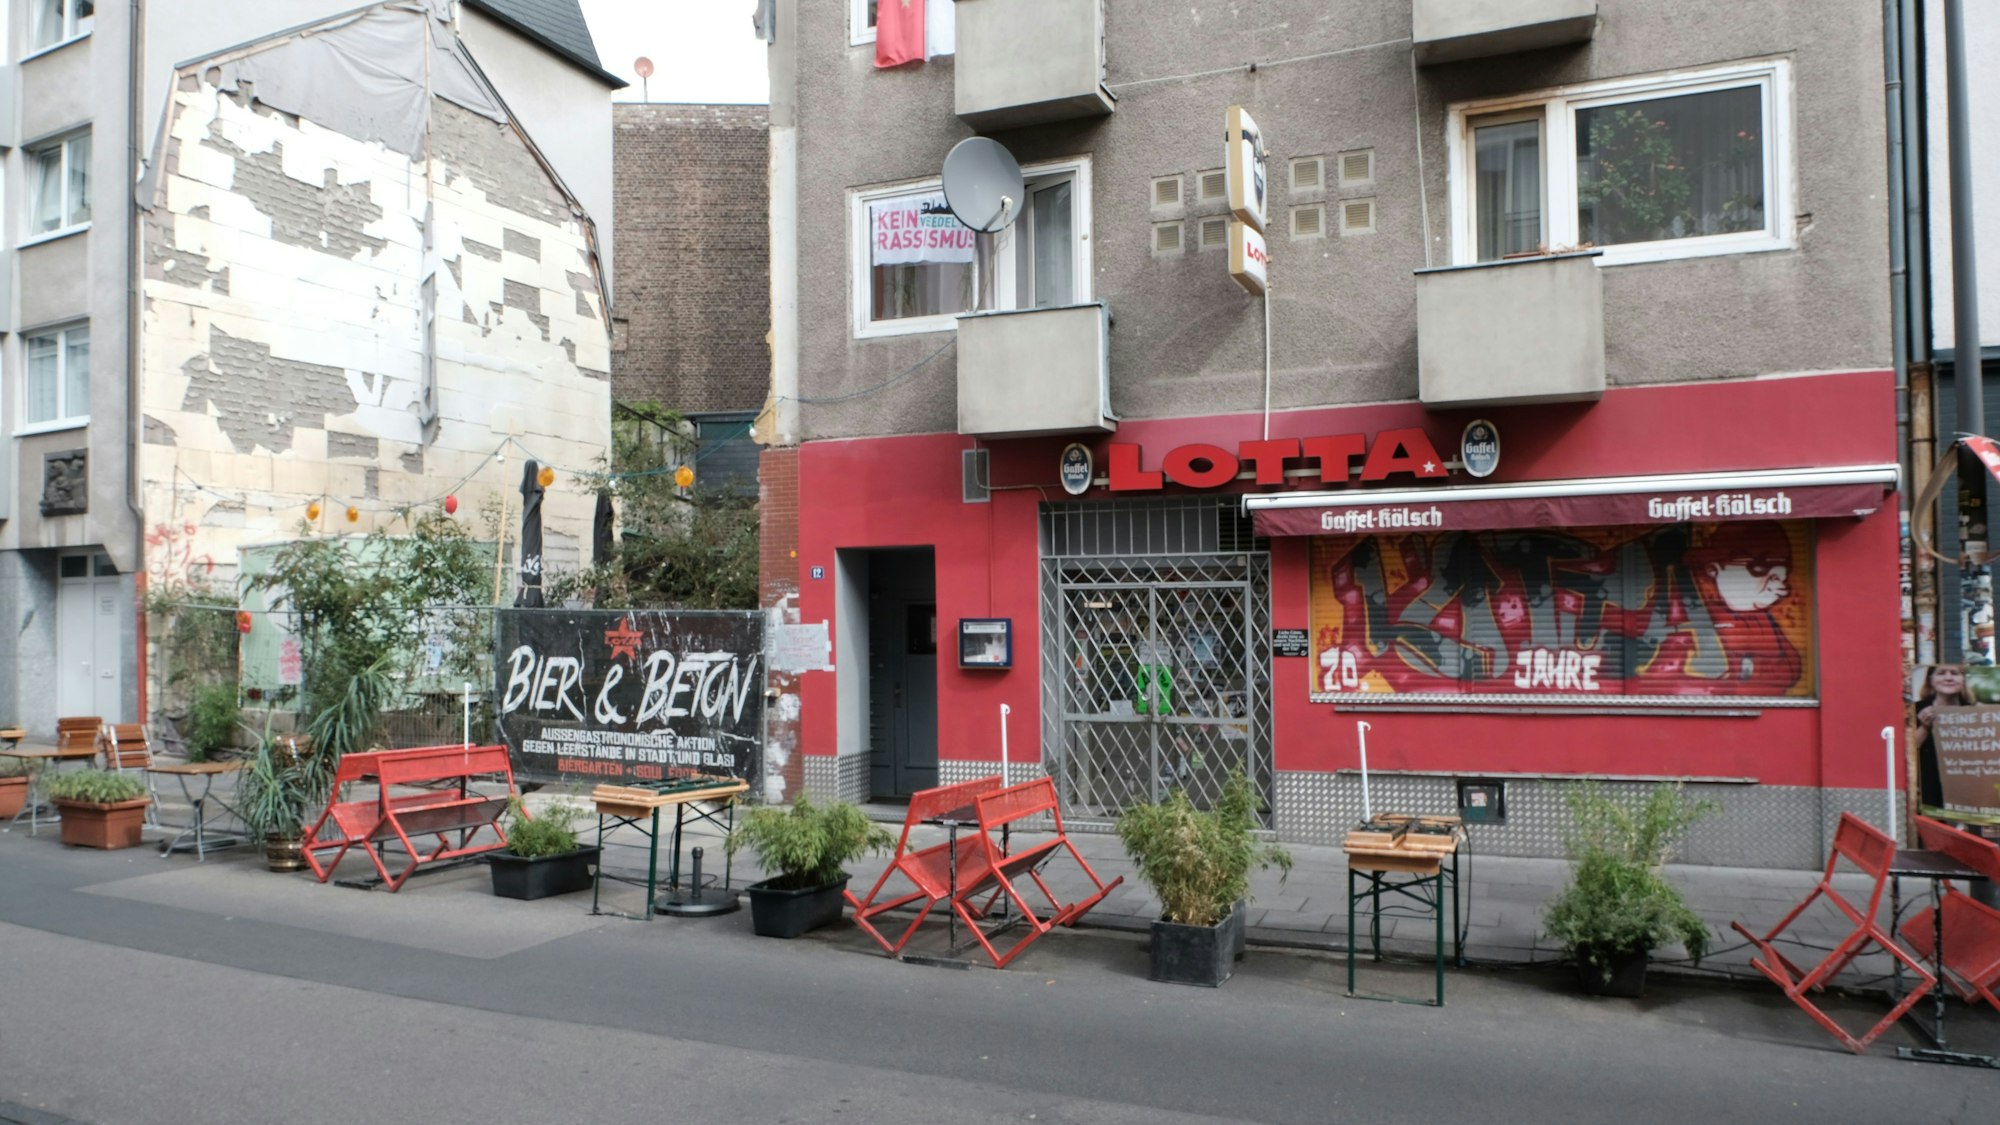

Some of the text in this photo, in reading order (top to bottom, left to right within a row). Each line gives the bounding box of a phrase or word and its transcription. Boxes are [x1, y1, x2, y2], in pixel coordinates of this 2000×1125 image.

[878, 209, 957, 230] KEIN VEEDEL
[878, 229, 976, 250] RASSISMUS
[1465, 441, 1496, 454] Gaffel
[1063, 462, 1088, 474] Gaffel
[1109, 427, 1450, 491] LOTTA
[812, 567, 822, 579] 12
[1514, 648, 1601, 691] JAHRE
[501, 645, 758, 729] BIER & BETON
[1938, 711, 1979, 725] DEINE
[541, 727, 716, 751] AUSSENGASTRONOMISCHE AKTION
[522, 739, 555, 754] GEGEN
[556, 742, 623, 759] LEERSTÄNDE
[625, 747, 636, 760] IN
[638, 748, 674, 763] STADT
[676, 750, 700, 765] UND
[557, 758, 623, 775] BIERGARTEN
[636, 765, 662, 779] SOUL
